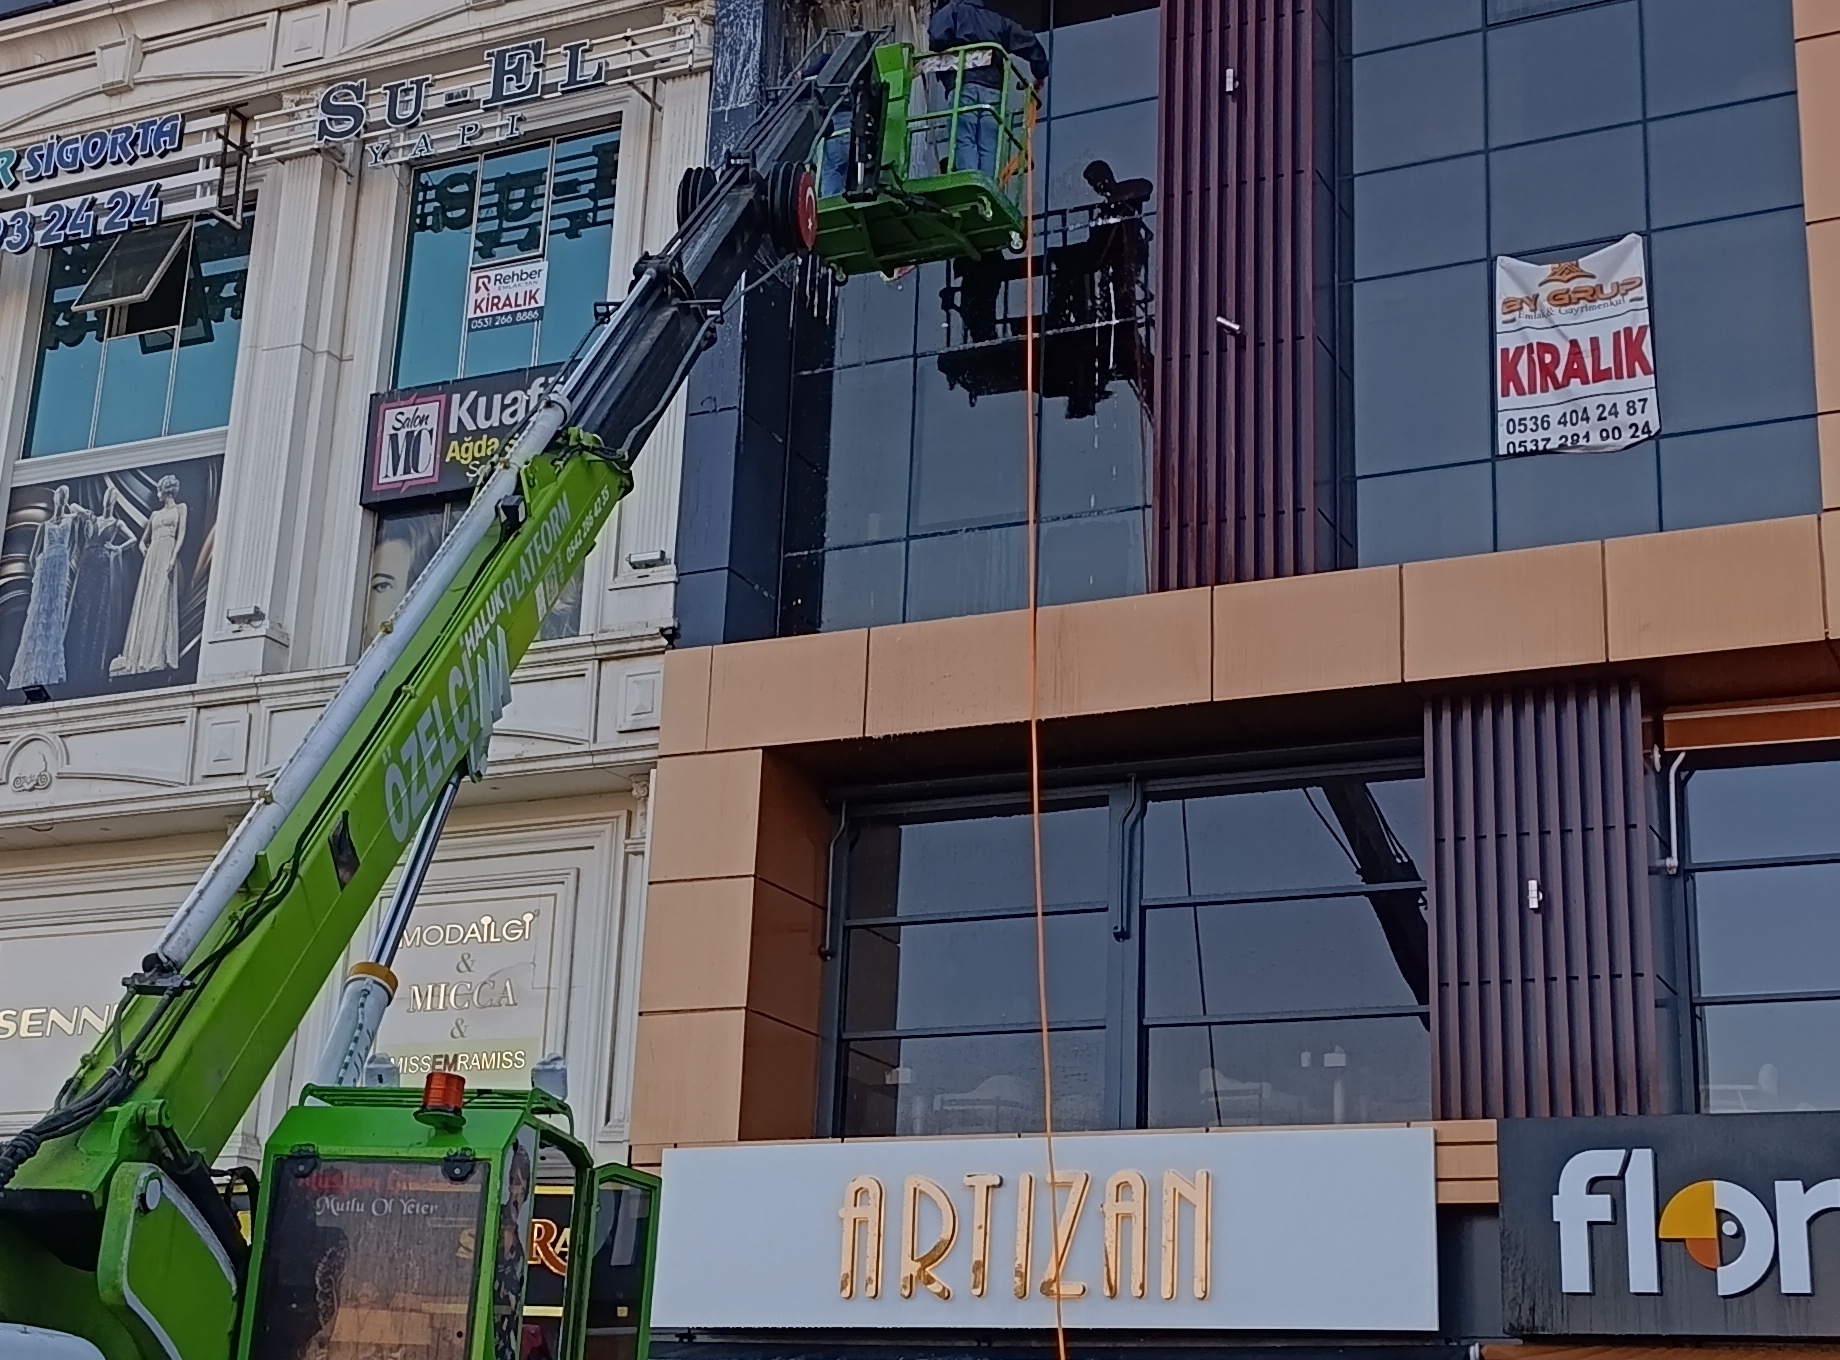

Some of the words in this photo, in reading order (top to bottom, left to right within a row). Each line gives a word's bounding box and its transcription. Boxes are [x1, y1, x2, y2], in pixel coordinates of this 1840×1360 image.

[316, 37, 606, 143] SU-EL
[23, 112, 182, 180] SİGORTA
[366, 111, 524, 167] YAPI
[38, 195, 96, 247] 24
[101, 183, 160, 235] 24
[494, 269, 543, 286] Rehber
[1547, 276, 1644, 307] GRUP
[473, 287, 541, 315] KİRALIK
[391, 405, 430, 432] Salon
[1506, 414, 1551, 435] 0536
[1557, 407, 1591, 427] 404
[1596, 401, 1619, 421] 24
[1626, 398, 1649, 415] 87
[1599, 425, 1622, 442] 90
[1628, 420, 1653, 439] 24
[382, 427, 433, 480] MC
[502, 490, 572, 615] PLATFORM
[463, 582, 505, 659] HALUK
[407, 977, 518, 1014] MICCA
[315, 1196, 365, 1216] Mutlu
[400, 1198, 438, 1216] Yeter
[838, 1166, 1217, 1305] ARTIZAN
